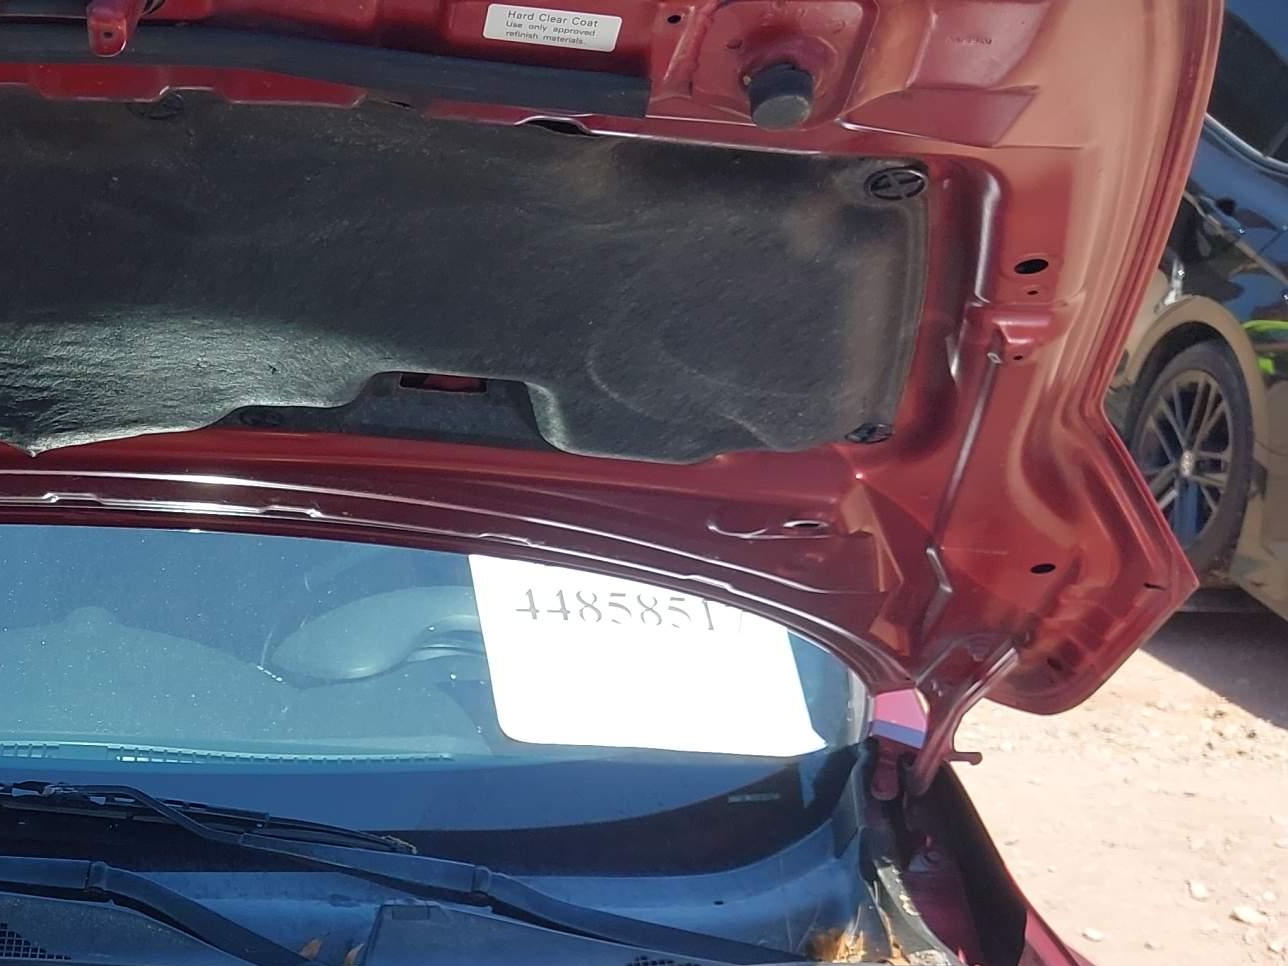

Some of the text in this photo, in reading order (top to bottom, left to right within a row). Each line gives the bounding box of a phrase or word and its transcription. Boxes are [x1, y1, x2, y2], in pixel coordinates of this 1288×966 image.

[507, 10, 598, 28] Hard Clear Coat
[506, 21, 596, 36] Use only approved
[506, 31, 538, 40] refinish
